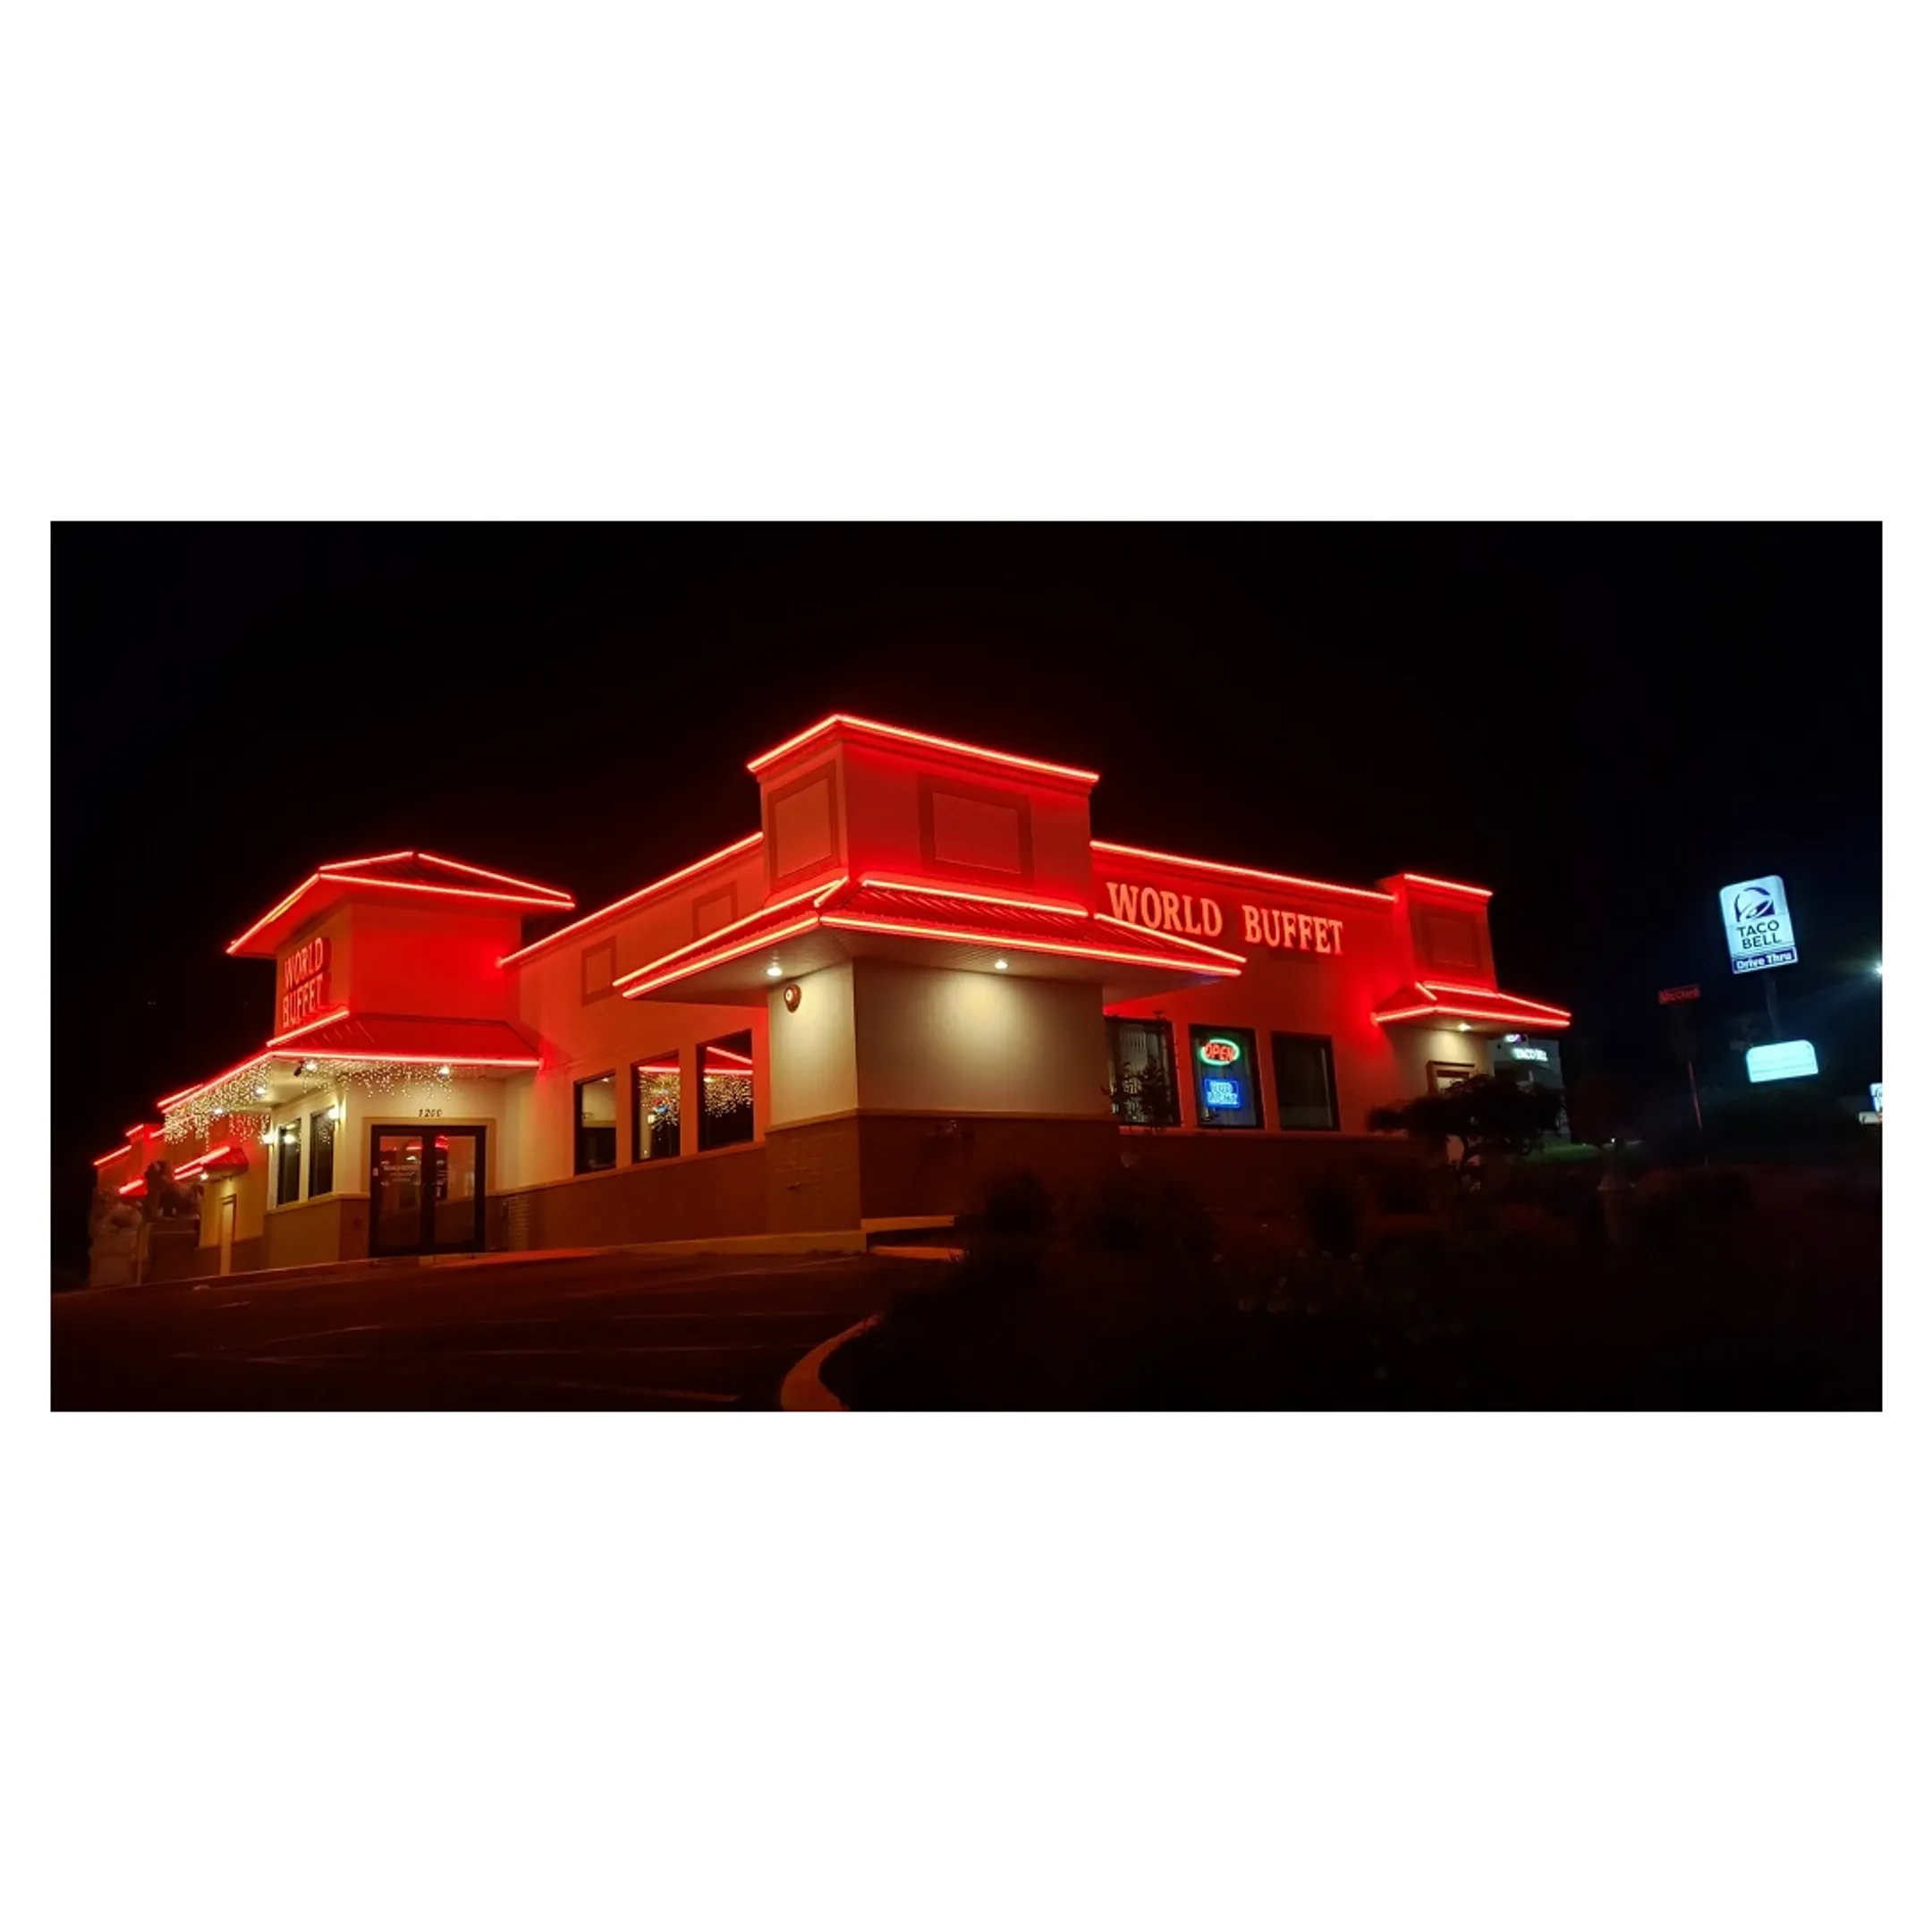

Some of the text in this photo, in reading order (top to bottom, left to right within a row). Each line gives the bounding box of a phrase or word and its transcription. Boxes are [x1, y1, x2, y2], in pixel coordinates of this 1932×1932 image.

[1106, 882, 1343, 955] WORLD BUFFET
[1736, 919, 1780, 937] TACO
[1741, 932, 1783, 949] BELL
[284, 937, 324, 991] WORLD
[1736, 952, 1792, 970] Drive Thru
[283, 972, 324, 1030] BUFFET
[1205, 1042, 1235, 1063] OPEN
[418, 1108, 444, 1118] 1200
